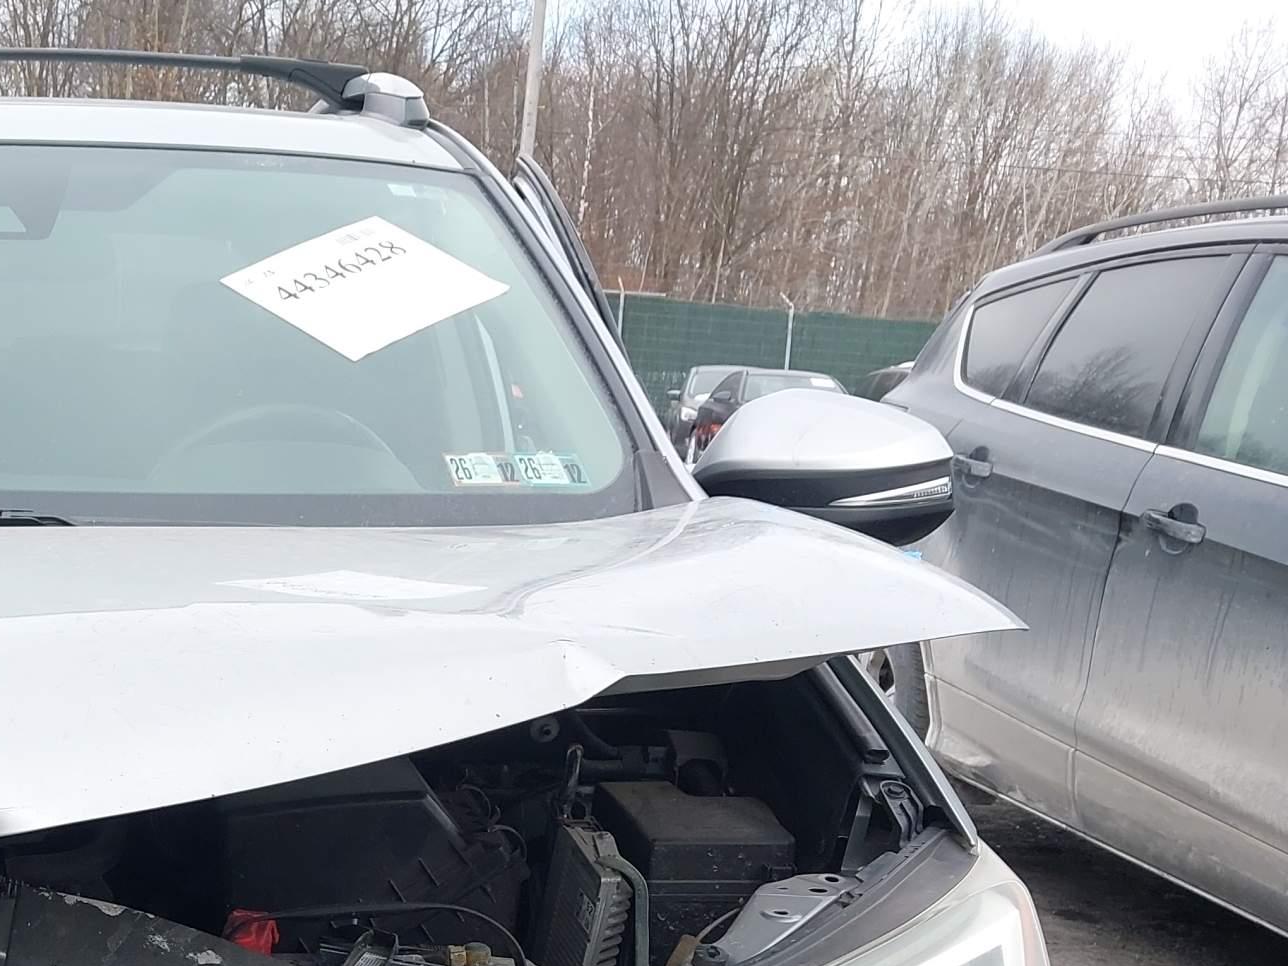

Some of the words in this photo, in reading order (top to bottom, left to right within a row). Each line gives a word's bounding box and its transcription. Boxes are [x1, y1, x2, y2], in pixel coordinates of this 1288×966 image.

[277, 240, 407, 300] 44346428
[449, 457, 473, 481] 26
[496, 462, 520, 483] 12
[518, 457, 542, 480] 26
[563, 463, 588, 484] 12
